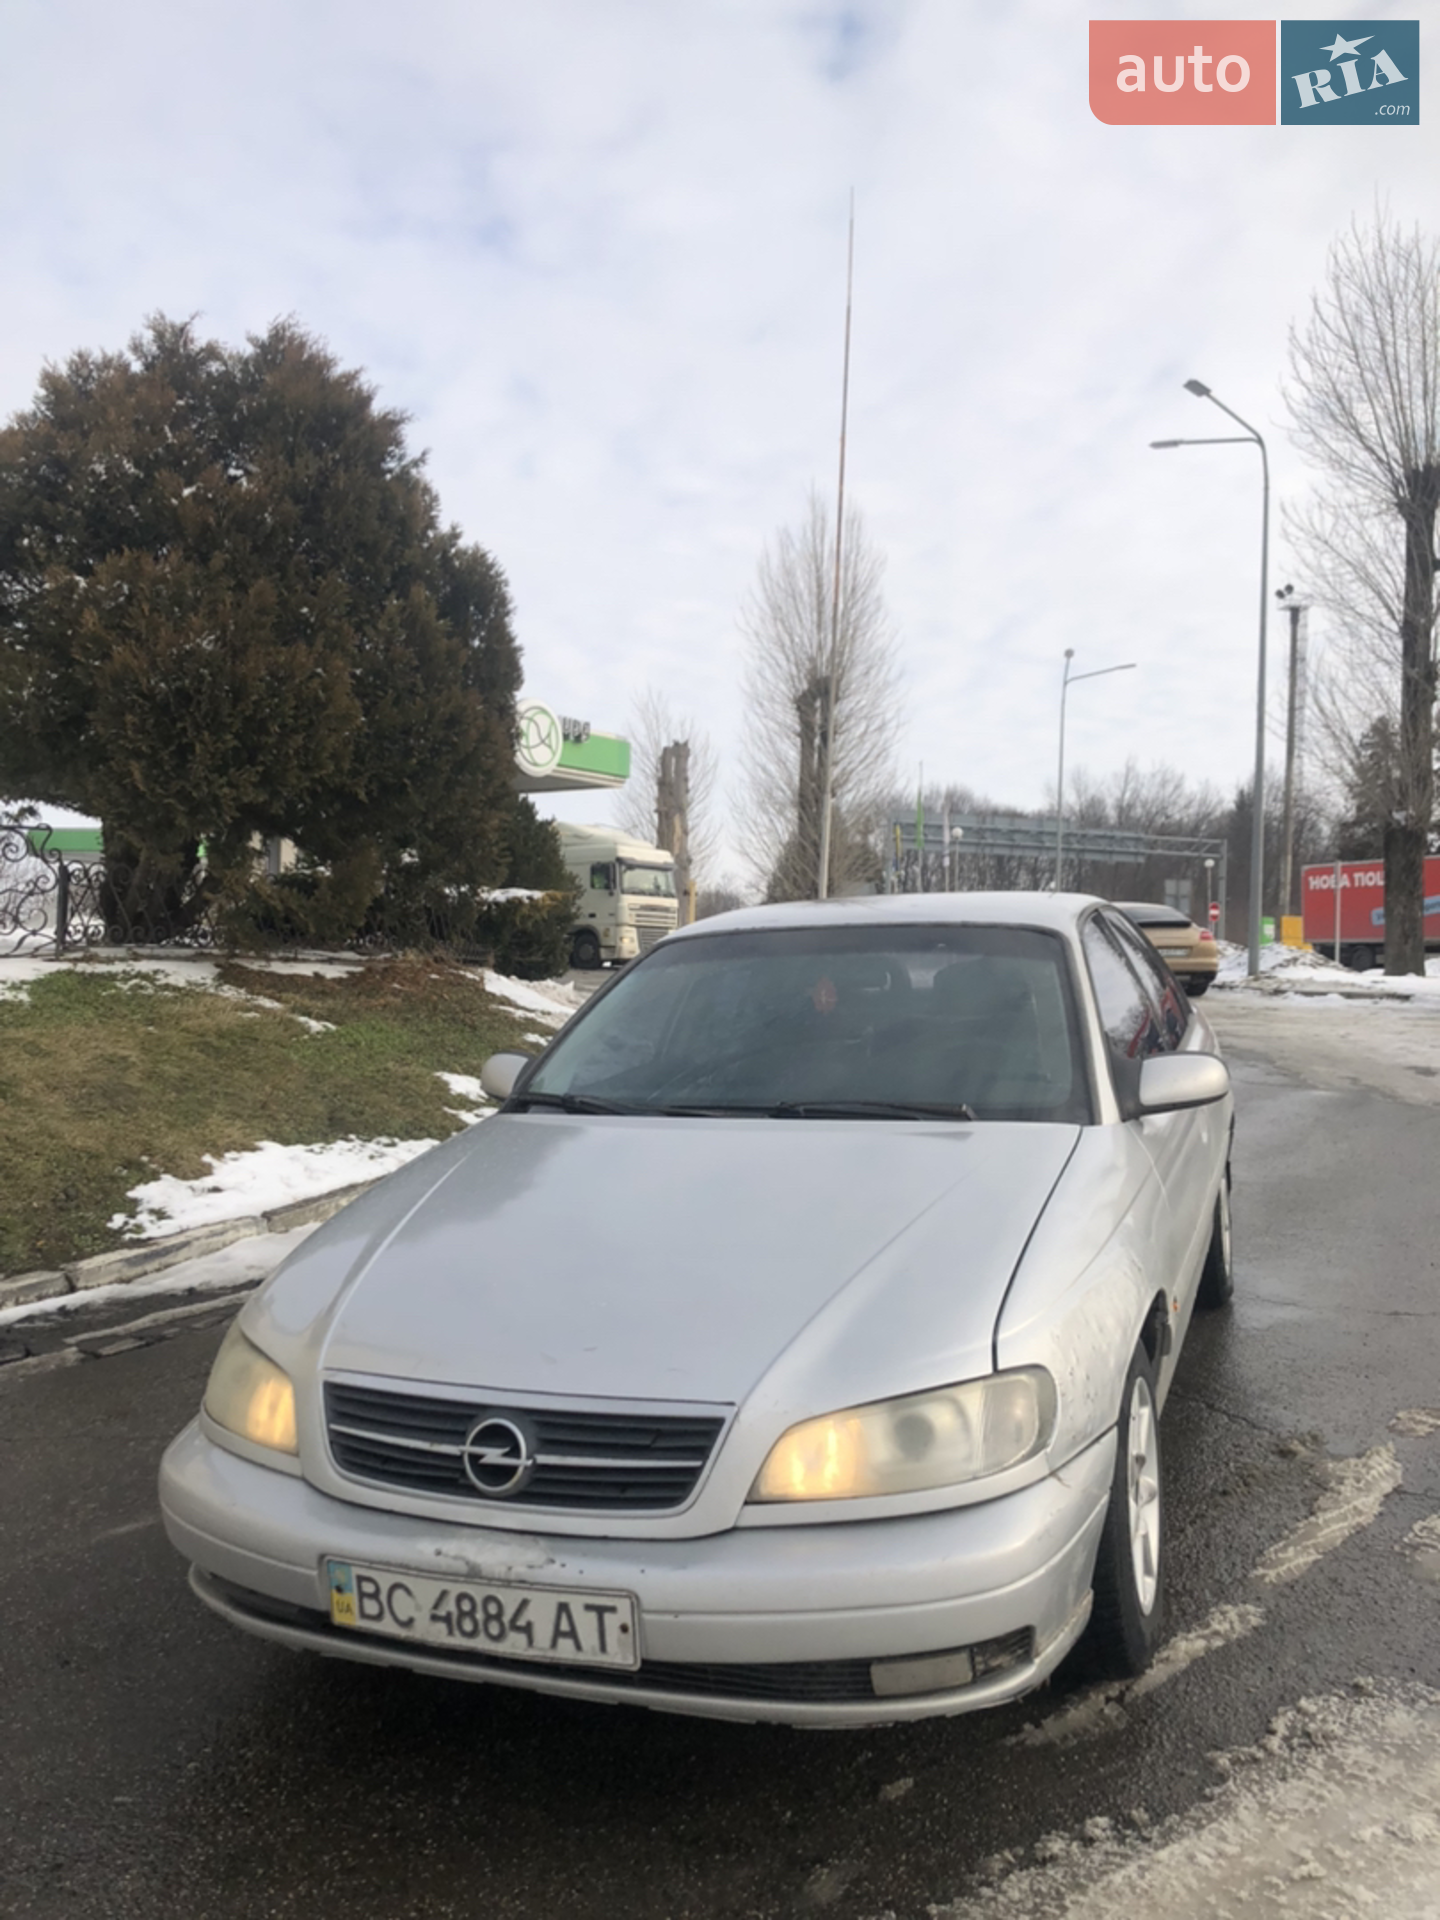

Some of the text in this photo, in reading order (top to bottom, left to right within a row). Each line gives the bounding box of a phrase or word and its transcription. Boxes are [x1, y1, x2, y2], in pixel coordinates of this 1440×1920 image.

[335, 1599, 354, 1615] UA
[355, 1574, 618, 1654] BC 4884 AT
